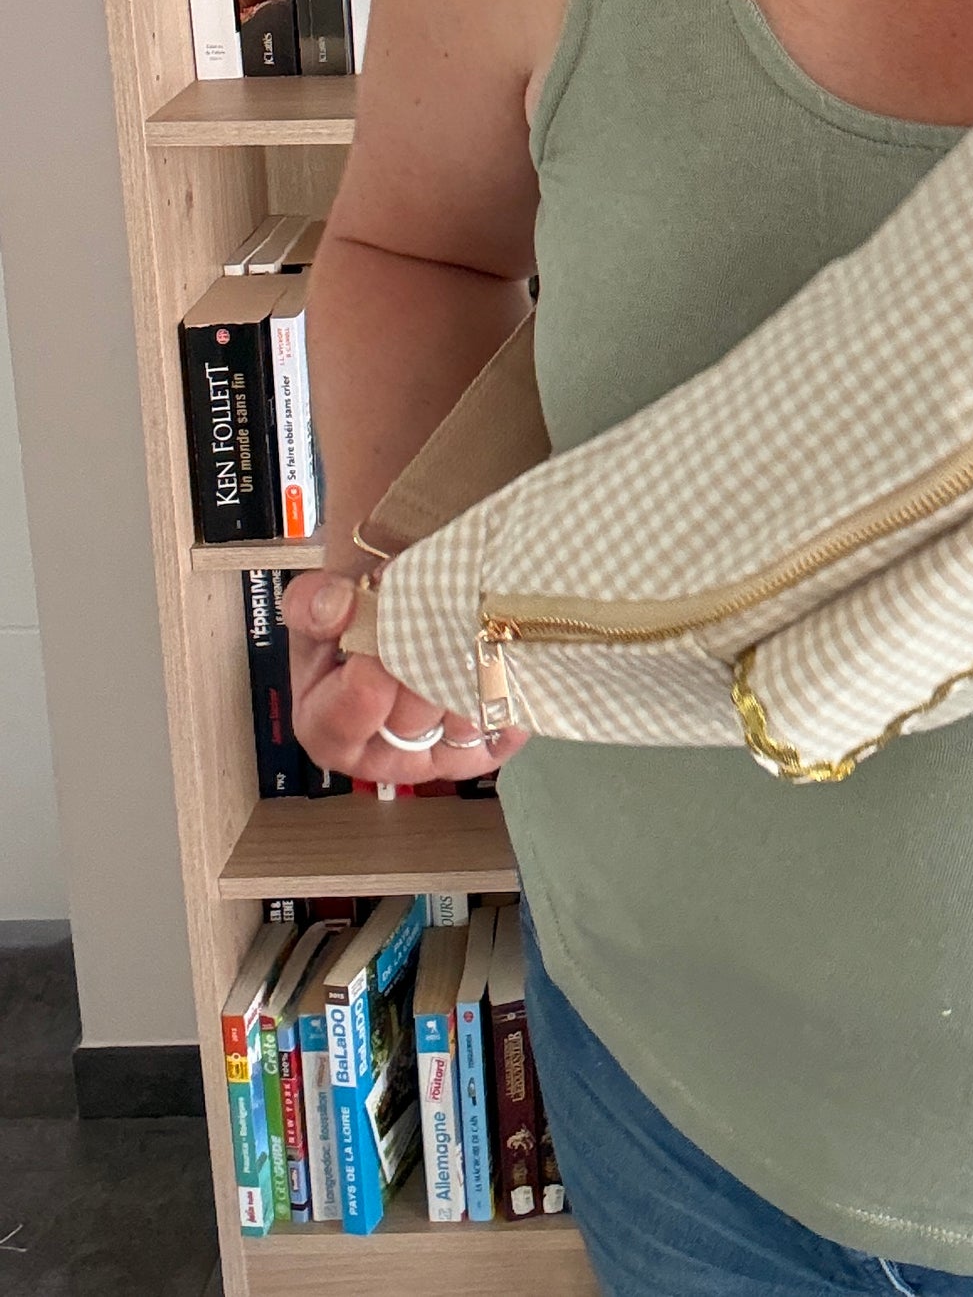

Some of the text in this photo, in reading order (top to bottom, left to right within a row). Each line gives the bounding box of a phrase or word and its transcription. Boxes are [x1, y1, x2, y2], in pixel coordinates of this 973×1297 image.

[282, 375, 293, 396] crier
[282, 398, 294, 418] sans
[204, 361, 241, 508] KEN FOLLETT
[231, 372, 254, 494] Un monde sans fin
[283, 420, 295, 444] obéir
[284, 445, 297, 467] faire
[287, 468, 298, 481] Se
[330, 1007, 351, 1084] BaLaDO
[430, 1059, 446, 1101] routard
[283, 1081, 294, 1114] YORK
[285, 1119, 296, 1144] NEW
[340, 1106, 358, 1217] PAYS DE LA LOIRE
[433, 1111, 451, 1202] Allemagne
